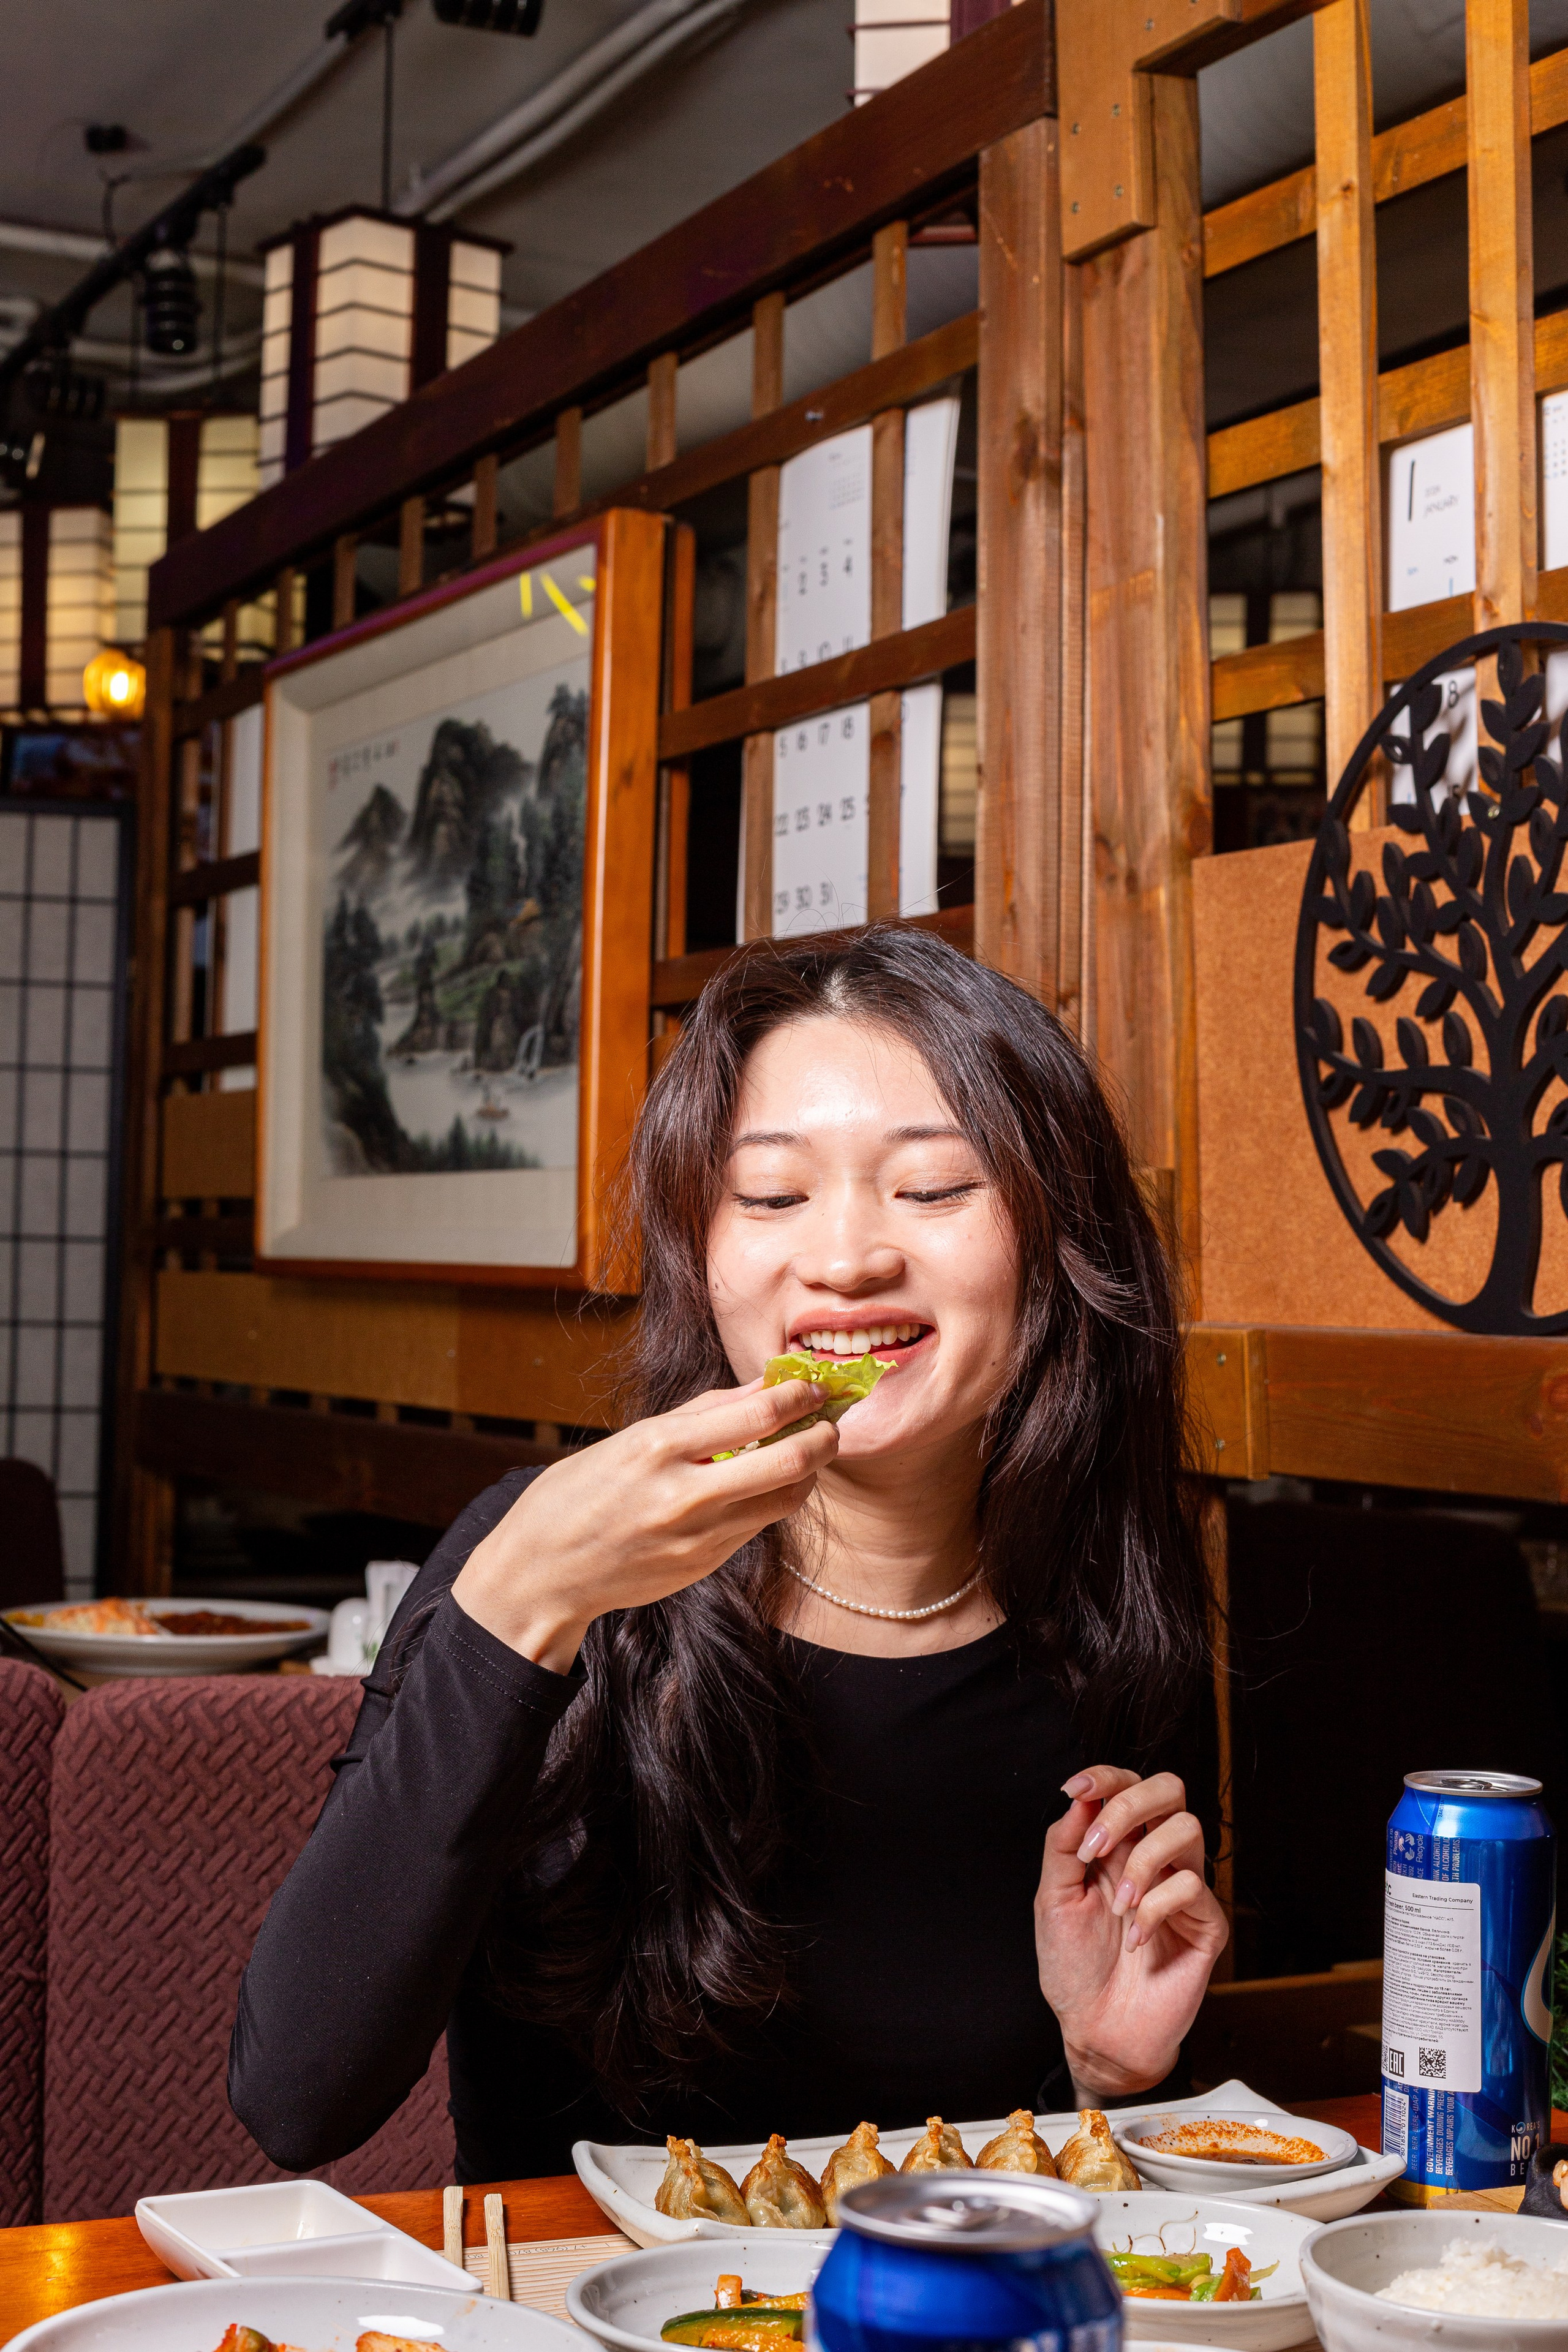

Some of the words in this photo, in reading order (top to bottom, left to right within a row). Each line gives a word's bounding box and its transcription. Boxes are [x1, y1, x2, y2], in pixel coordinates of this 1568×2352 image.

[1447, 680, 1460, 709] 8
[1415, 1834, 1425, 1863] Recycle
[1426, 2120, 1434, 2173] GOVERNMENT
[1510, 2163, 1525, 2176] BE
